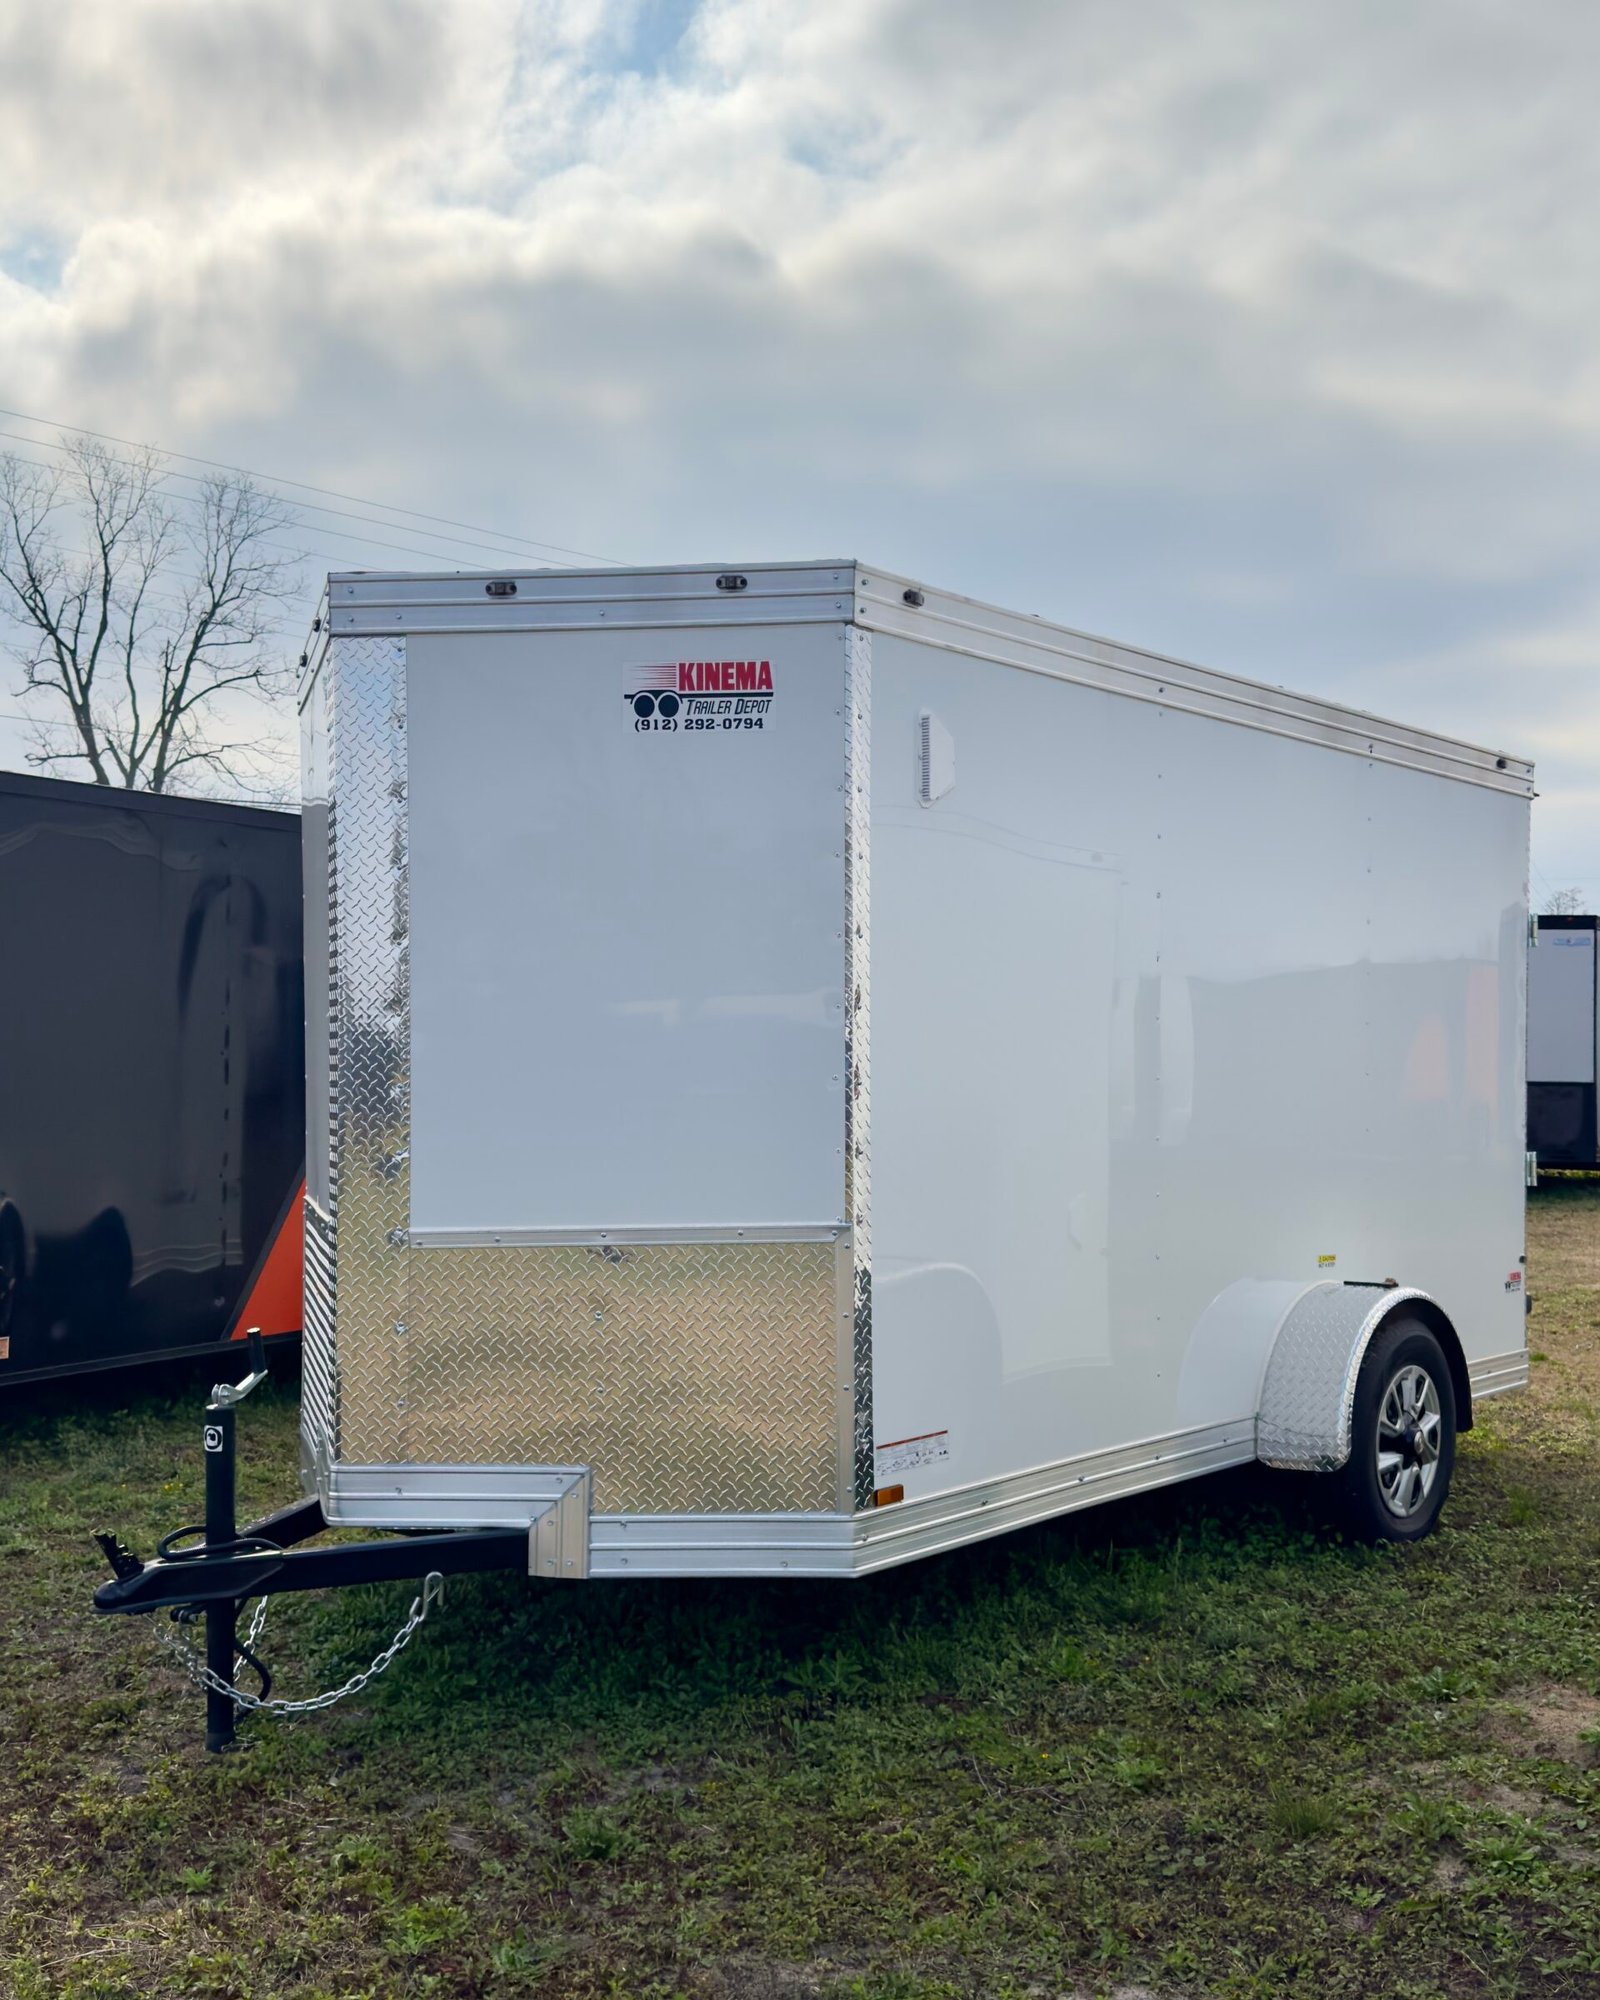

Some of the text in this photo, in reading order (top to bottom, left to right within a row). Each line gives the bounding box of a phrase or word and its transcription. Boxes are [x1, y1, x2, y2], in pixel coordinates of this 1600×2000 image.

[679, 661, 773, 691] KINEMA
[635, 718, 764, 732] (912) 292-0794
